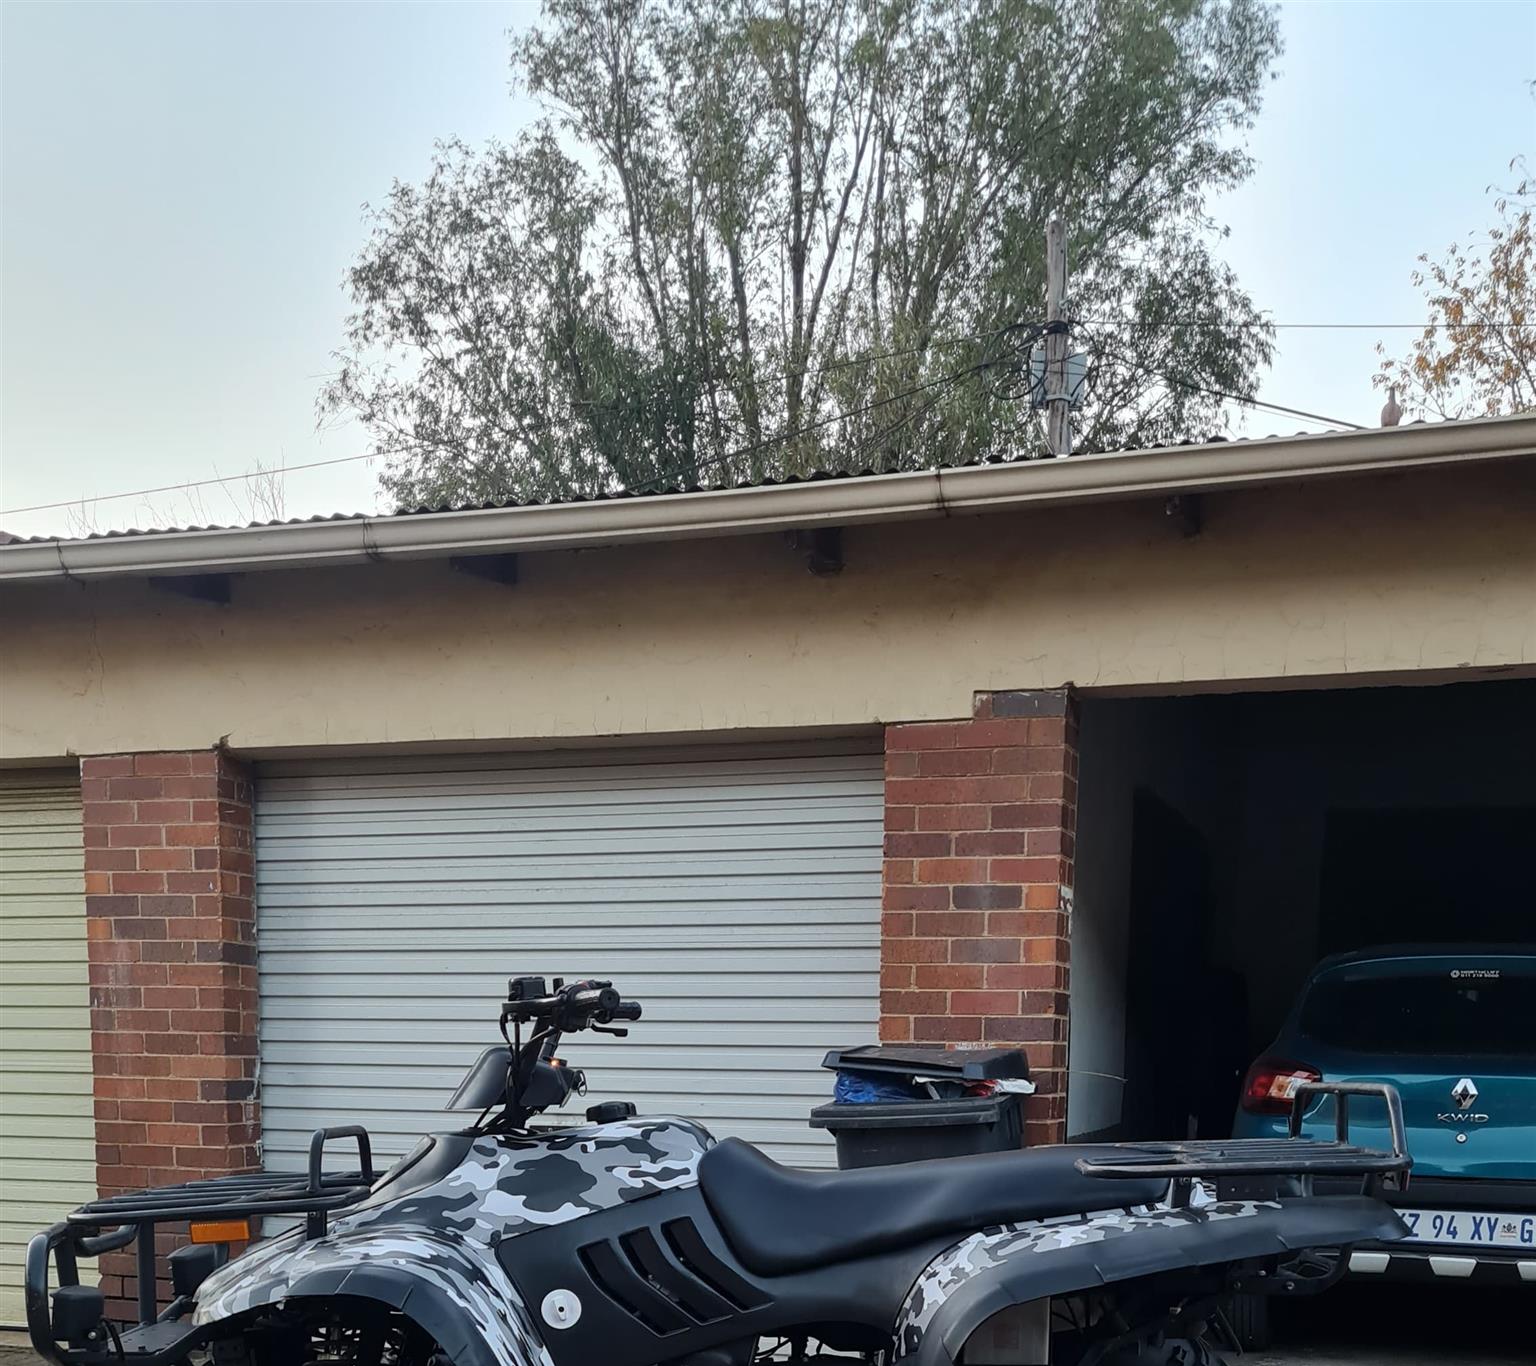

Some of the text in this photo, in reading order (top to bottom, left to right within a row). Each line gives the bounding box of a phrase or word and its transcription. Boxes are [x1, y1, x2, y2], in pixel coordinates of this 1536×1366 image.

[1402, 1213, 1534, 1244] Z 94 XY G
